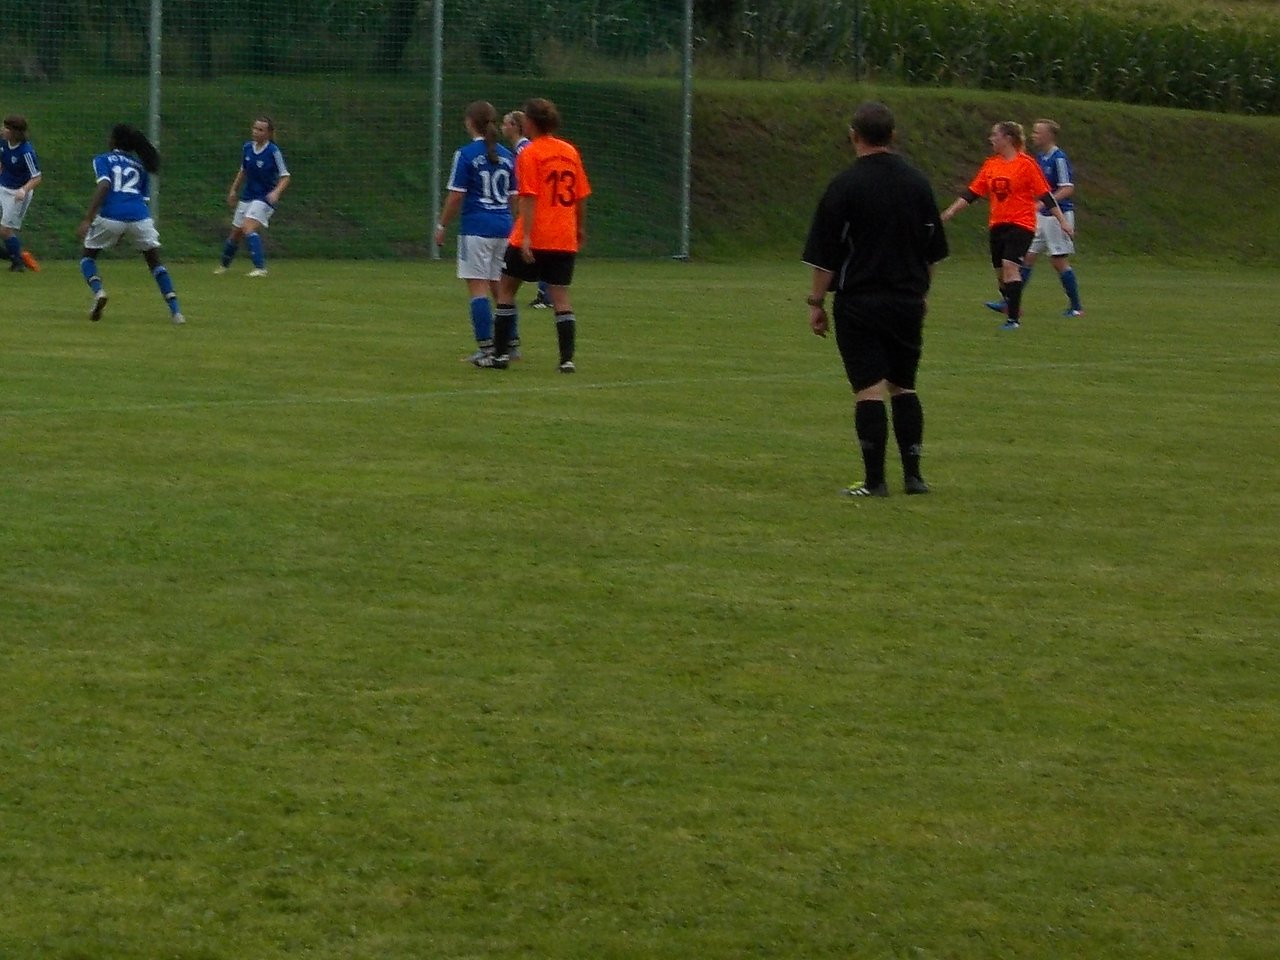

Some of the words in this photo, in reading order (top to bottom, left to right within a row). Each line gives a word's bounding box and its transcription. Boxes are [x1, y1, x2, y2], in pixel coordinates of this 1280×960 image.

[112, 165, 140, 194] 12
[479, 169, 510, 203] 10
[545, 170, 576, 207] 13
